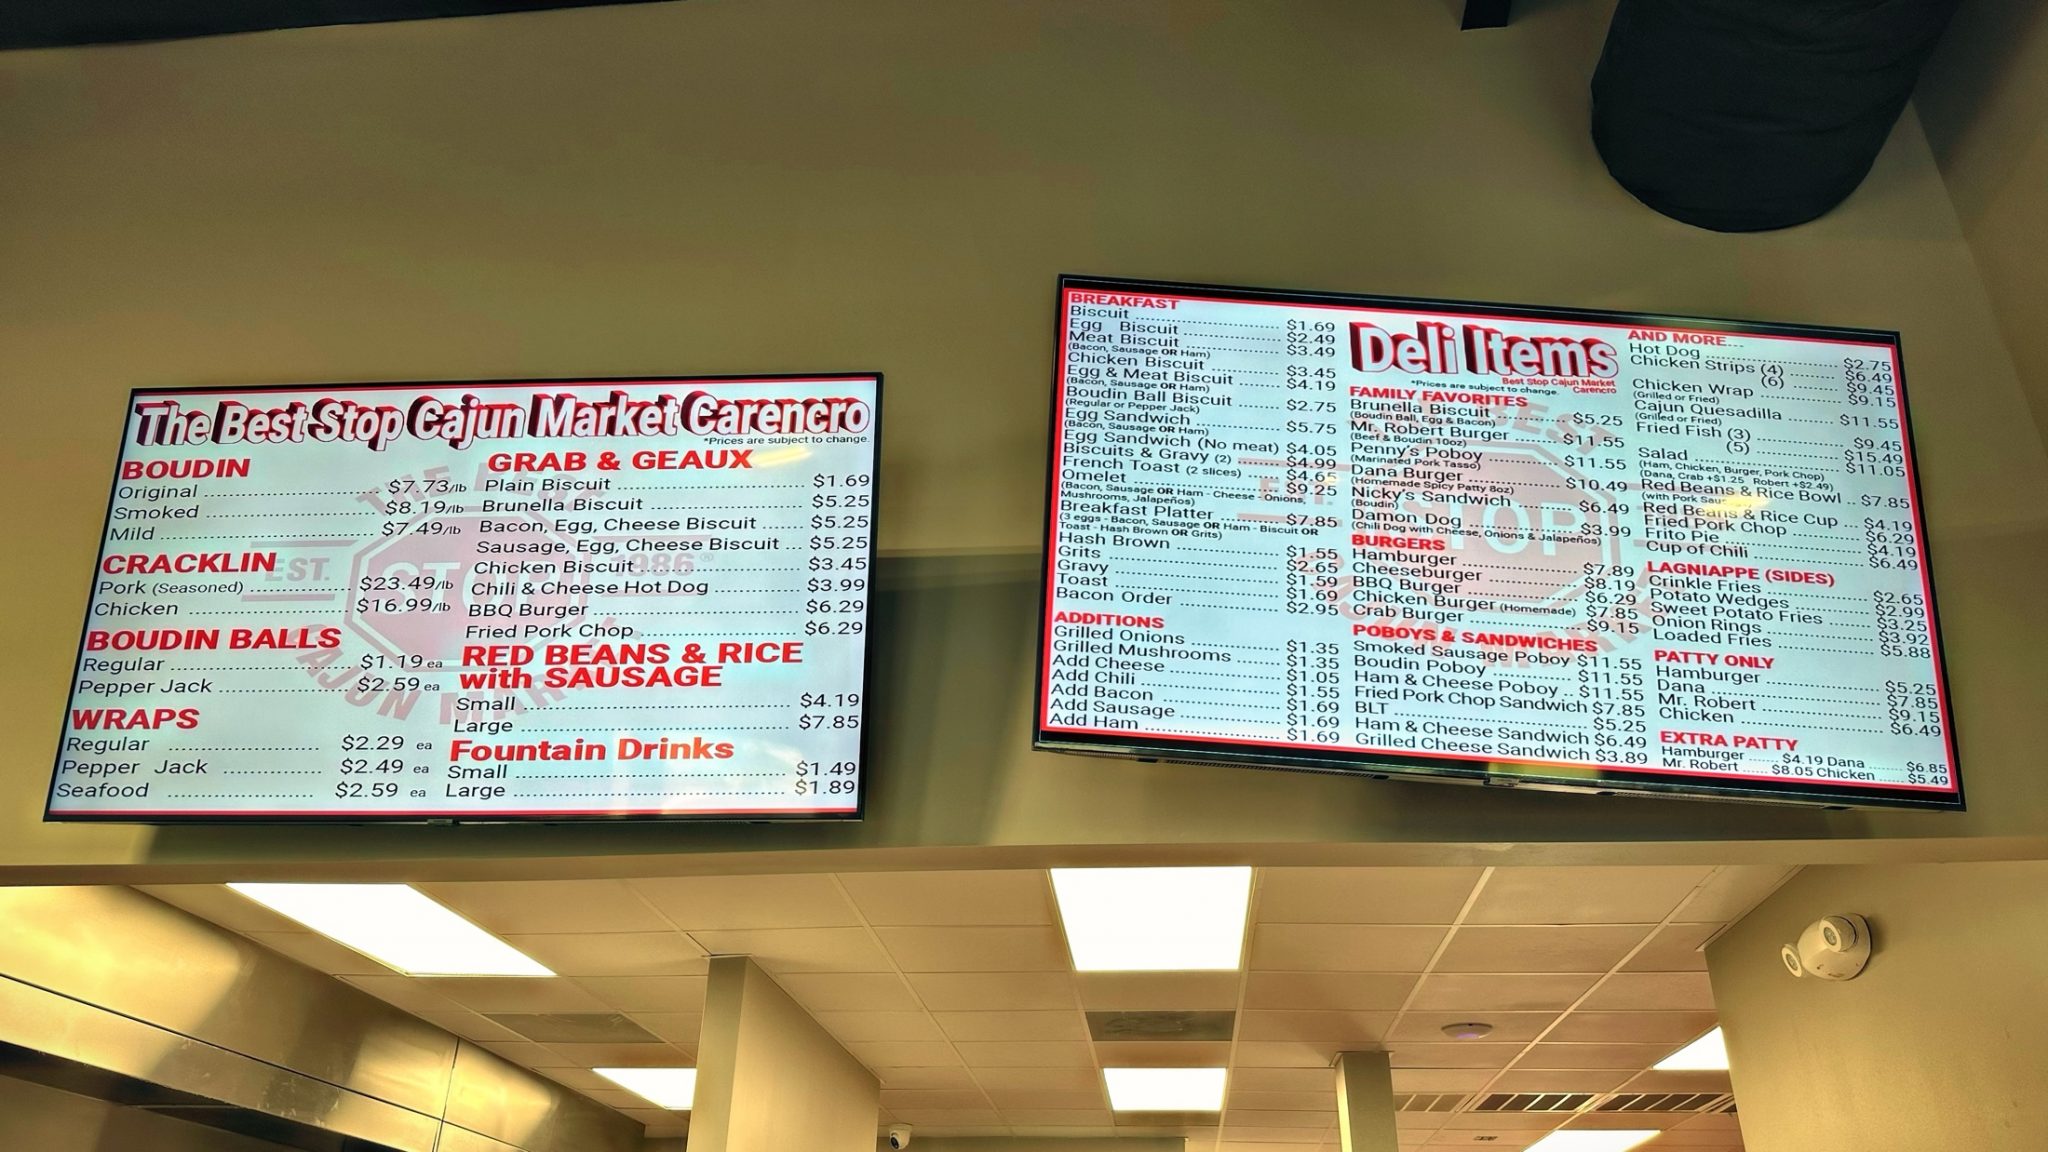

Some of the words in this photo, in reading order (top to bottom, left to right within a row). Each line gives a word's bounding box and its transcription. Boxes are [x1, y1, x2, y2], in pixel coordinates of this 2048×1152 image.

[1070, 292, 1179, 309] BREAKFAST
[1070, 304, 1128, 319] Biscuit
[1286, 318, 1335, 332] $1.69
[1069, 329, 1113, 343] Meat
[1120, 333, 1178, 347] Biscuit
[1286, 343, 1335, 357] $3.49
[1627, 329, 1667, 342] AND
[1067, 342, 1109, 353] (Bacon,
[1111, 345, 1158, 355] Sausage
[1160, 348, 1178, 356] OR
[1180, 349, 1210, 359] Ham)
[1349, 321, 1459, 374] Deli
[1462, 324, 1619, 378] Items
[1629, 342, 1660, 355] Hot
[1665, 345, 1700, 360] Dog
[1843, 356, 1891, 372] $2.75
[1067, 351, 1137, 366] Chicken
[1145, 356, 1203, 370] Biscuit
[1286, 364, 1336, 379] $3.45
[1502, 377, 1524, 385] Best
[1527, 378, 1548, 388] Stop
[1551, 378, 1580, 388] Cajun
[1581, 379, 1616, 388] Market
[1573, 386, 1617, 394] Carencro
[1632, 378, 1702, 393] Chicken
[1708, 383, 1754, 399] Wrap
[1847, 392, 1896, 408] $9.15
[1349, 385, 1416, 400] FAMILY
[1422, 390, 1528, 407] FAVORITES
[136, 401, 211, 447] The
[213, 402, 307, 445] Best
[308, 399, 404, 452] Stop
[407, 394, 524, 451] Cajun
[530, 391, 681, 438] Market
[681, 394, 870, 437] Carencro
[1350, 398, 1422, 413] Brunella
[1429, 403, 1490, 418] Biscuit
[1572, 411, 1623, 426] $5.25
[767, 435, 808, 445] subject
[825, 435, 869, 444] change.
[121, 458, 250, 480] BOUDIN
[487, 451, 587, 472] GRAB
[596, 451, 621, 471] &
[631, 449, 753, 470] GEAUX
[1062, 455, 1123, 469] French
[1129, 459, 1179, 473] Toast
[1186, 465, 1198, 476] (2
[1202, 467, 1241, 479] slices)
[1638, 446, 1688, 461] Salad
[1845, 459, 1906, 477] $11.05
[484, 478, 534, 492] Plain
[541, 477, 611, 491] Biscuit
[812, 472, 869, 488] $1.69
[1351, 463, 1397, 477] Dana
[1403, 466, 1463, 483] Burger
[1565, 477, 1628, 492] $10.49
[118, 483, 198, 502] Original
[113, 504, 199, 520] Smoked
[109, 526, 155, 541] Mild
[1351, 534, 1445, 551] BURGERS
[1645, 526, 1686, 541] Frito
[1691, 529, 1719, 543] Pie
[1867, 541, 1916, 557] $4.19
[102, 552, 277, 574] CRACKLIN
[1352, 547, 1457, 567] Hamburger
[1583, 561, 1634, 577] $7.89
[1647, 560, 1760, 580] LAGNIAPPE
[1764, 569, 1835, 587] (SIDES)
[98, 579, 146, 595] Pork
[151, 580, 243, 596] (Seasoned)
[471, 581, 515, 596] Chili
[521, 582, 535, 595] &
[540, 580, 619, 595] Cheese
[624, 580, 661, 594] Hot
[667, 580, 708, 596] Dog
[807, 577, 865, 593] $3.99
[94, 601, 178, 616] Chicken
[468, 603, 513, 618] BBQ
[519, 603, 588, 619] Burger
[805, 598, 864, 615] $6.29
[1056, 586, 1114, 601] Bacon
[1121, 591, 1171, 605] Order
[1286, 601, 1338, 616] $2.95
[1054, 610, 1164, 629] ADDITIONS
[1352, 603, 1397, 618] Crab
[1402, 606, 1463, 624] Burger
[1586, 618, 1639, 634] $9.15
[1651, 614, 1706, 629] Onion
[1710, 618, 1762, 636] Rings
[1878, 629, 1929, 646] $3.92
[85, 629, 220, 651] BOUDIN
[229, 627, 341, 649] BALLS
[1054, 625, 1113, 640] Grilled
[1119, 629, 1184, 645] Onions
[1286, 639, 1339, 655] $1.35
[1353, 624, 1436, 641] POBOYS
[1441, 629, 1455, 642] &
[1461, 631, 1598, 652] SANDWICHES
[82, 656, 165, 675] Regular
[360, 653, 424, 671] $1.19
[427, 659, 443, 670] ea
[461, 644, 534, 666] RED
[544, 643, 670, 666] BEANS
[681, 642, 706, 664] &
[717, 642, 804, 663] RICE
[1654, 649, 1719, 665] PATTY
[1724, 654, 1774, 669] ONLY
[459, 666, 532, 689] with
[543, 665, 723, 688] SAUSAGE
[1354, 654, 1419, 670] Boudin
[1426, 659, 1486, 678] Poboy
[1578, 668, 1643, 686] $11.55
[77, 679, 156, 697] Pepper
[160, 677, 212, 693] Jack
[356, 675, 420, 693] $2.59
[423, 683, 440, 691] ea
[1657, 678, 1705, 694] Dana
[1886, 693, 1938, 710] $7.85
[71, 708, 200, 730] WRAPS
[453, 718, 513, 735] Large
[798, 713, 859, 730] $7.85
[1049, 712, 1087, 726] Add
[1094, 715, 1138, 730] Ham
[1286, 727, 1340, 744] $1.69
[1355, 700, 1388, 714] BLT
[1593, 716, 1646, 733] $5.25
[449, 738, 606, 762] Fountain
[617, 737, 734, 760] Drinks
[1355, 732, 1416, 748] Grilled
[1420, 737, 1493, 754] Cheese
[1497, 742, 1590, 761] Sandwich
[1595, 747, 1648, 765] $3.89
[1660, 730, 1728, 747] EXTRA
[1733, 735, 1797, 751] PATTY
[1661, 745, 1744, 762] Hamburger
[1782, 752, 1825, 767] $4.19
[1827, 756, 1865, 769] Dana
[1905, 760, 1947, 774] $6.85
[56, 781, 149, 798] Seafood
[334, 780, 398, 799] $2.59
[409, 789, 426, 797] ea
[445, 783, 505, 800] Large
[794, 778, 856, 796] $1.89
